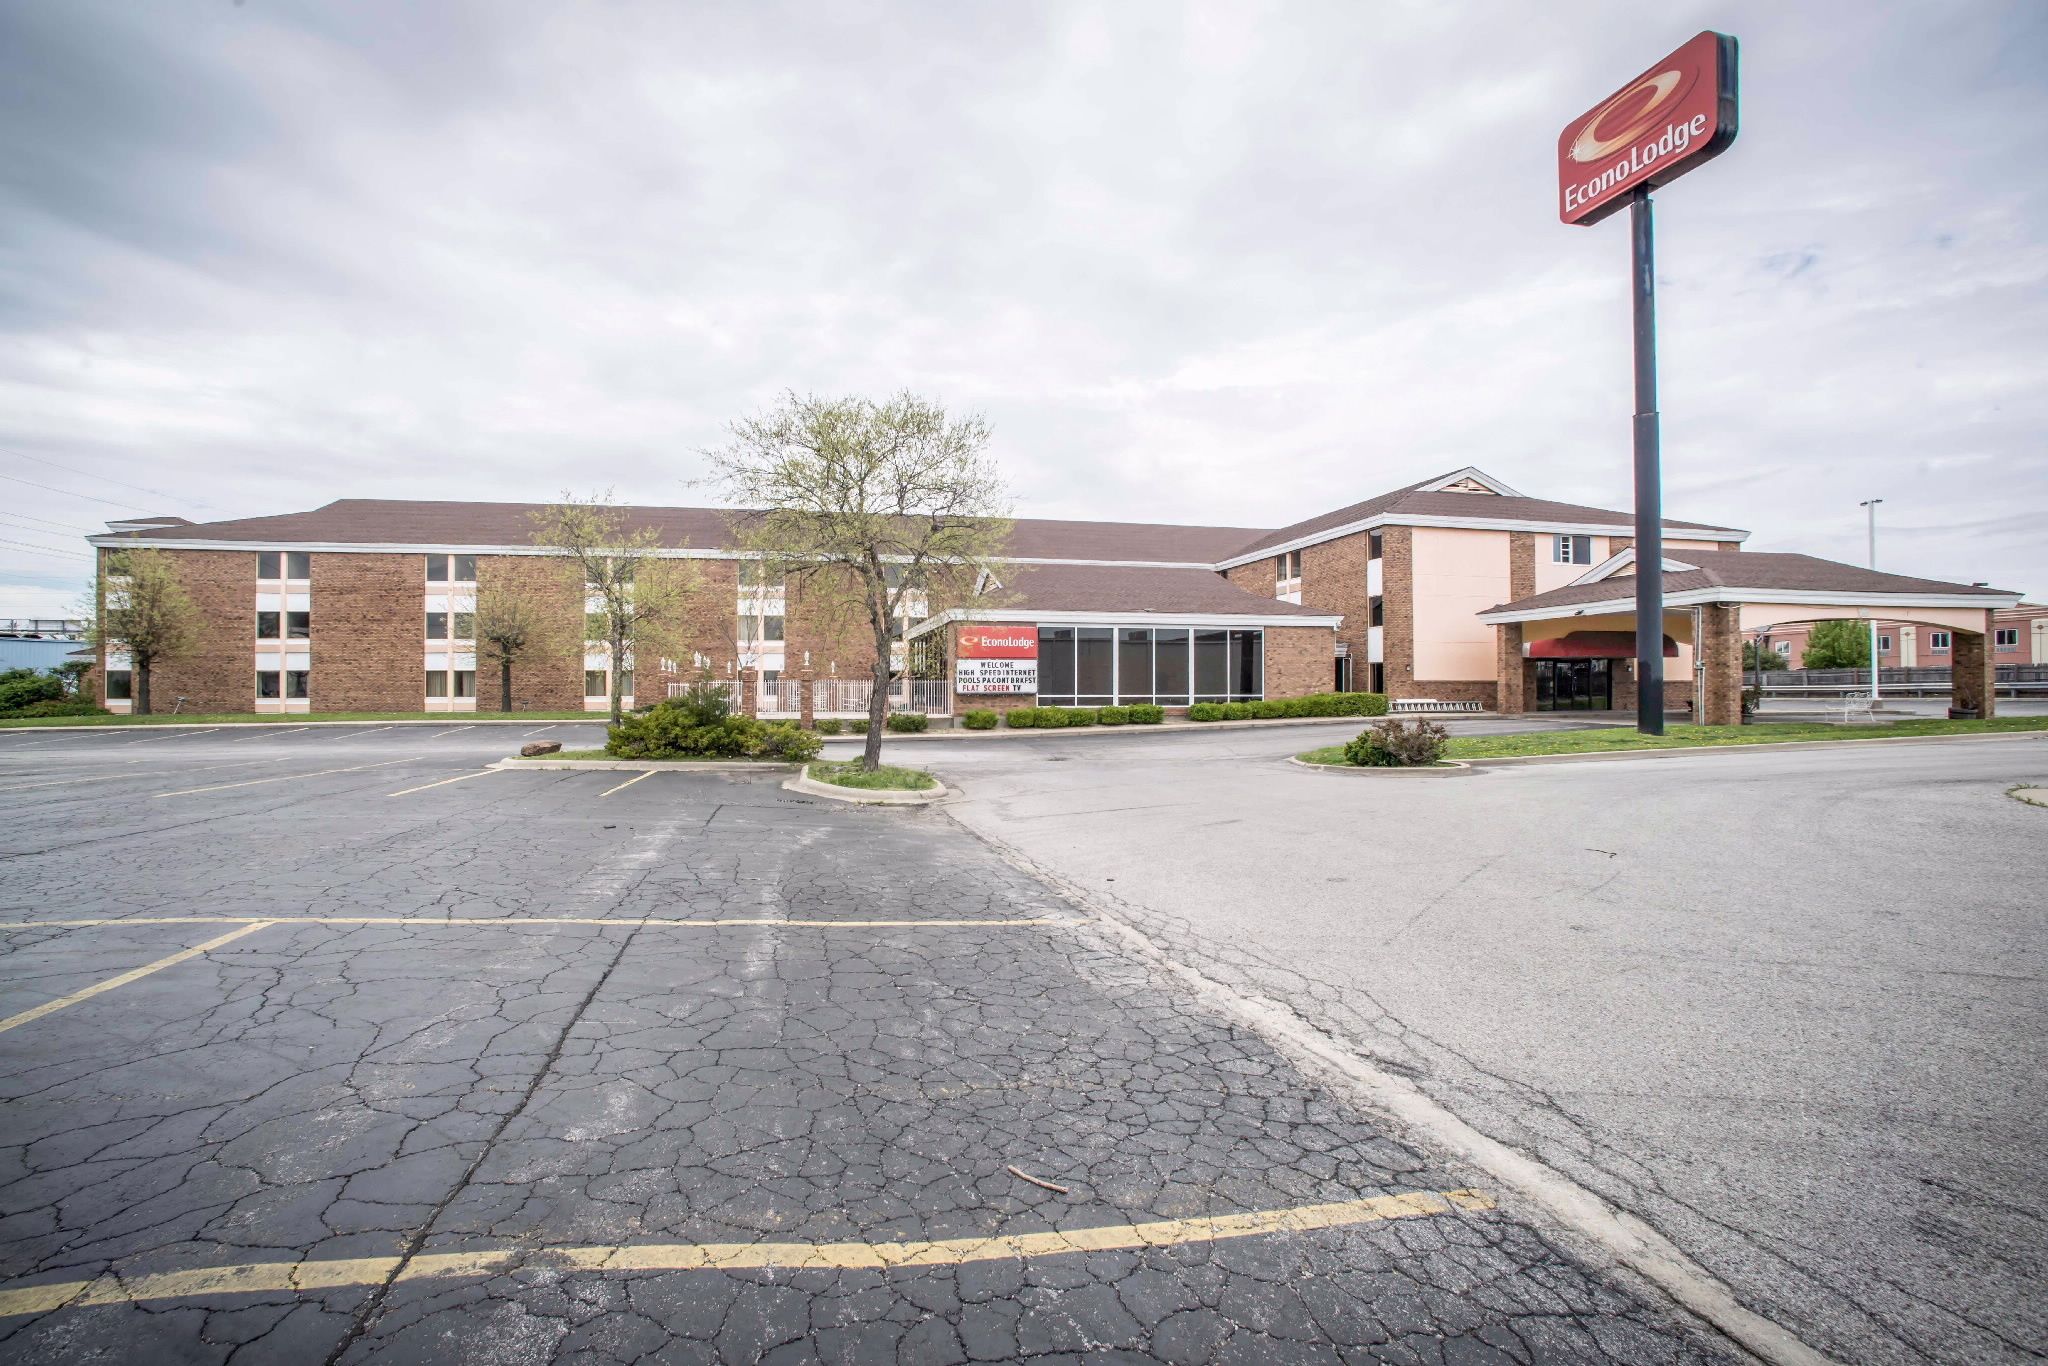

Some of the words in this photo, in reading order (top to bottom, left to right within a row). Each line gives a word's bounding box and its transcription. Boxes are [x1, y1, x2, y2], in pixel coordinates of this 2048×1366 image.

[1565, 113, 1707, 213] EconoLodge
[981, 636, 1034, 649] EconoLodge
[980, 661, 1014, 669] WELCOME
[962, 684, 980, 692] FLAT
[983, 684, 1010, 692] SCREEN
[1013, 684, 1022, 692] TV
